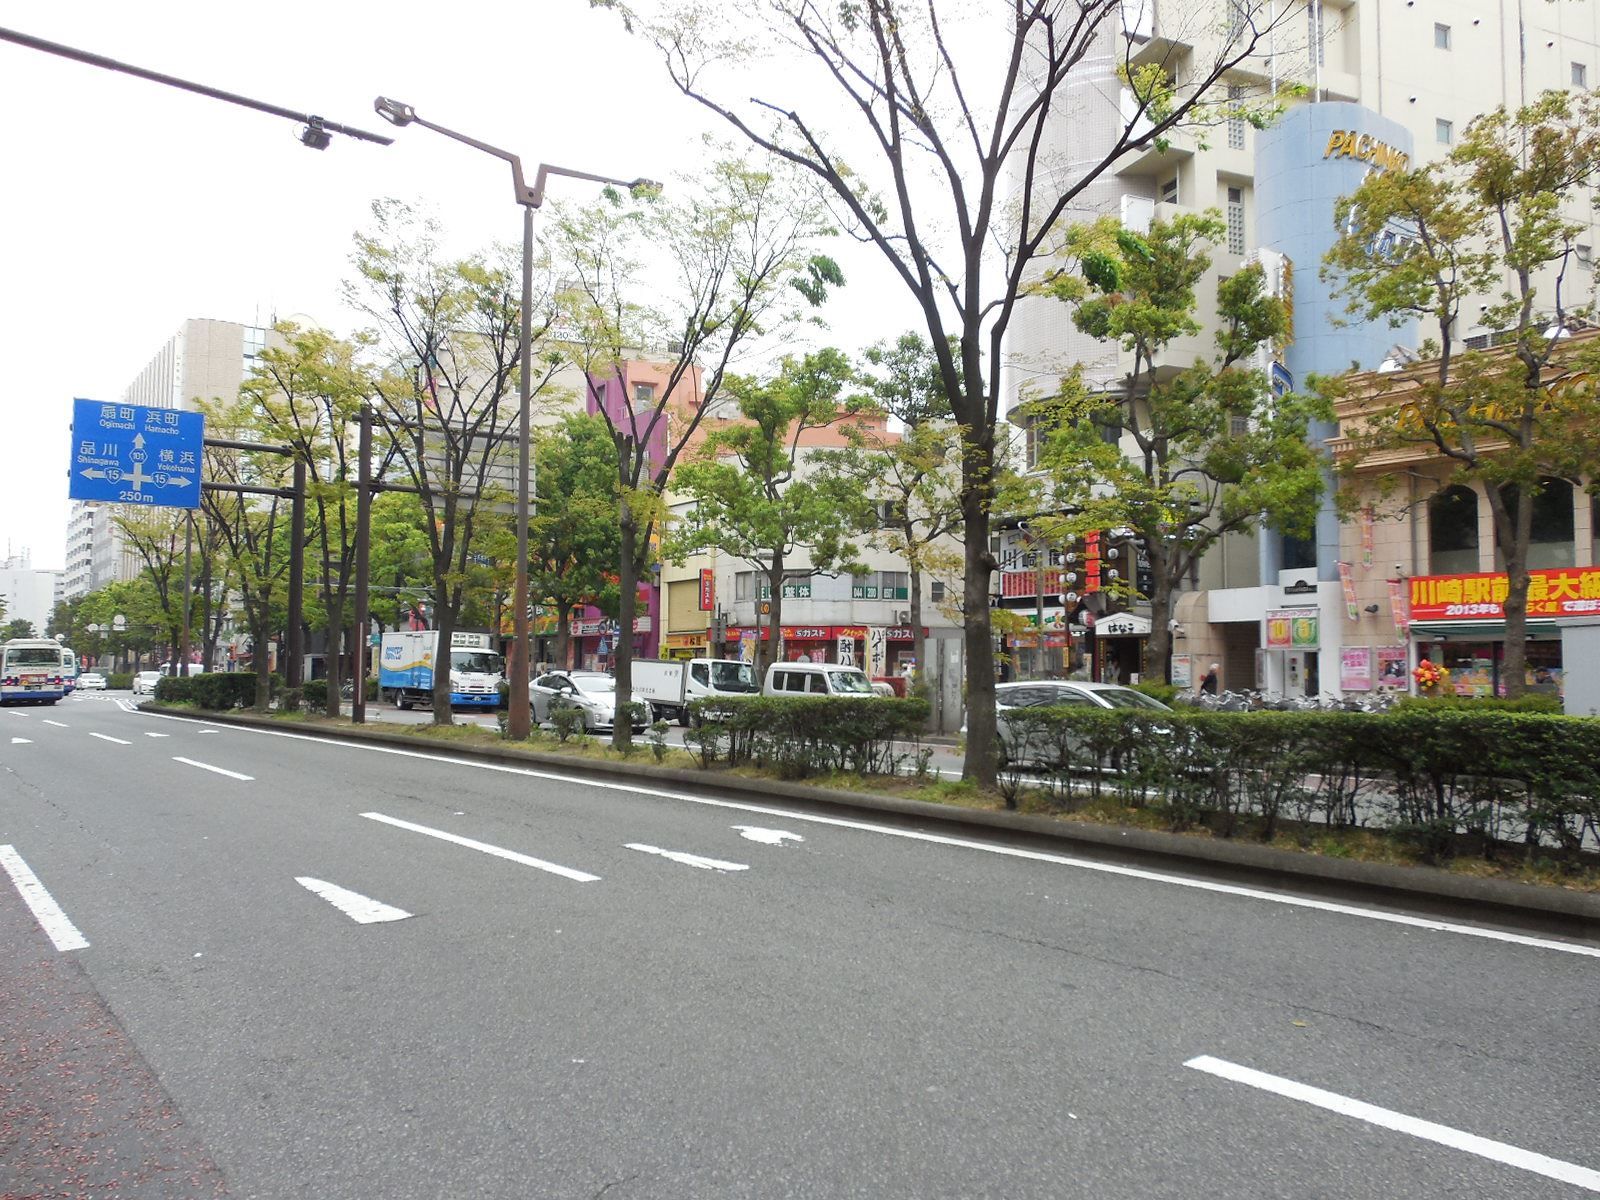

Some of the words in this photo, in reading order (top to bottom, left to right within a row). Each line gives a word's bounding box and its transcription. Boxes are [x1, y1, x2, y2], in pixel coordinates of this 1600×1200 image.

[1323, 130, 1410, 172] PACHINKO
[100, 405, 135, 421] 扇町
[146, 410, 179, 426] 浜町
[99, 419, 136, 430] Ogimachi
[144, 424, 180, 435] Hamacho
[80, 440, 118, 457] 品川
[158, 449, 195, 465] 横浜
[132, 452, 144, 460] 101
[77, 455, 119, 467] Shinagawa
[157, 463, 196, 474] Yokohama
[107, 470, 120, 480] 15
[154, 474, 166, 484] 15
[796, 628, 826, 637] Sガスト
